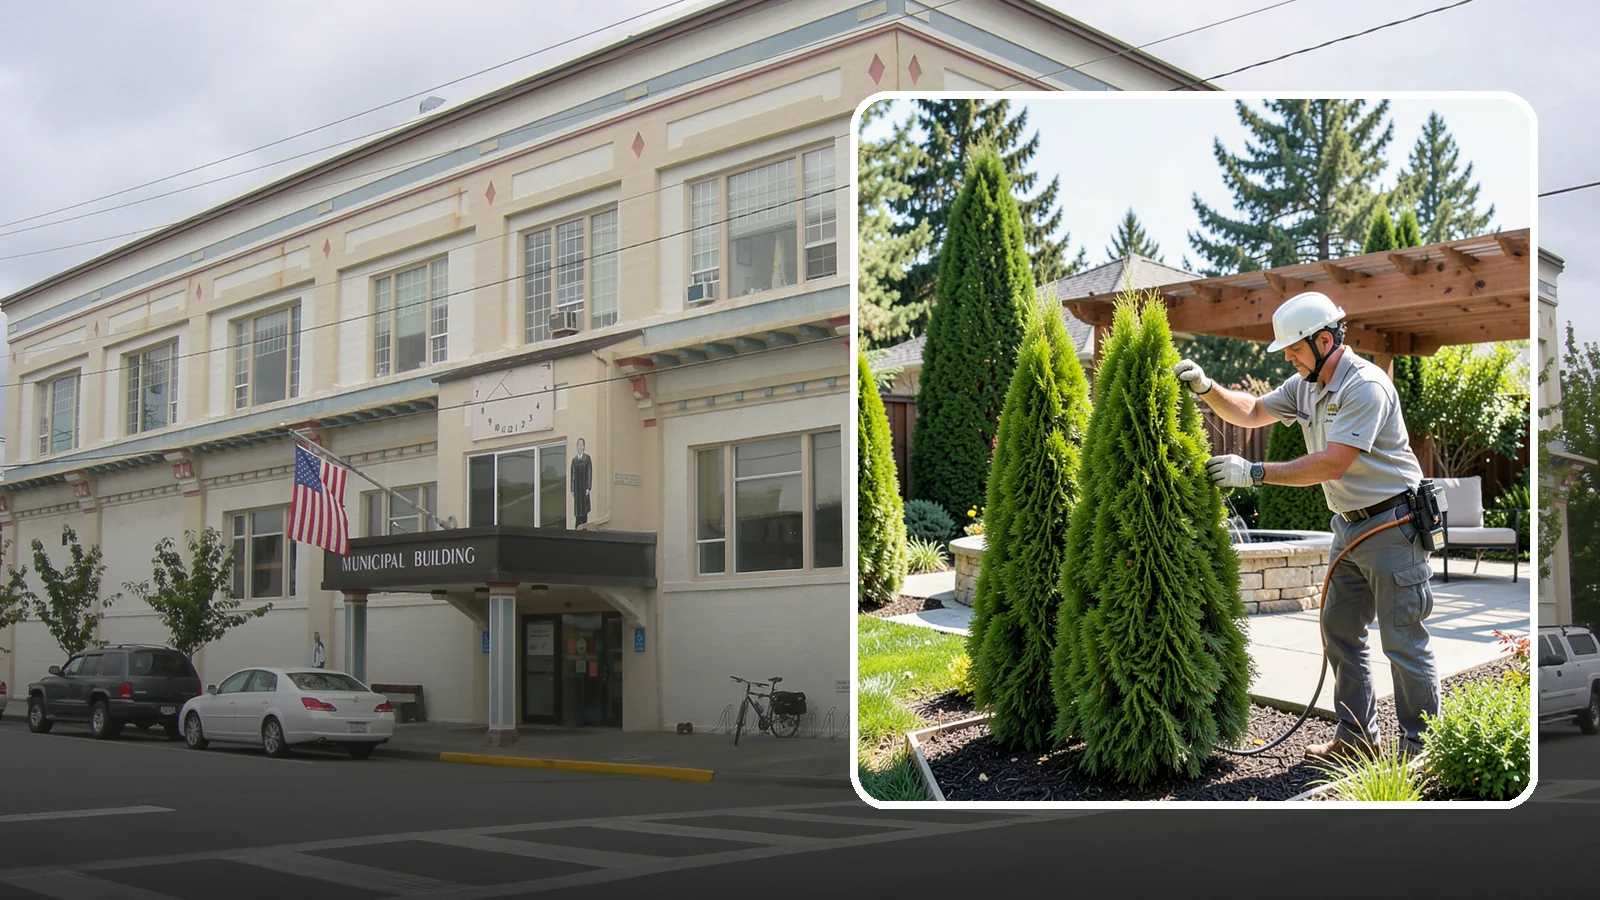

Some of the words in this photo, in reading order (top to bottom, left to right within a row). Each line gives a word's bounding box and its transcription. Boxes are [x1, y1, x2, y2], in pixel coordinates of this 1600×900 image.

[475, 390, 480, 398] 7
[536, 402, 540, 410] 4
[480, 407, 485, 415] 8
[488, 417, 492, 426] 9
[529, 414, 533, 422] 3
[494, 424, 500, 432] 10
[521, 420, 525, 428] 2
[501, 425, 506, 433] 11
[507, 425, 514, 433] 12
[342, 552, 405, 572] MUNICIPAL
[414, 546, 475, 567] BUILDING
